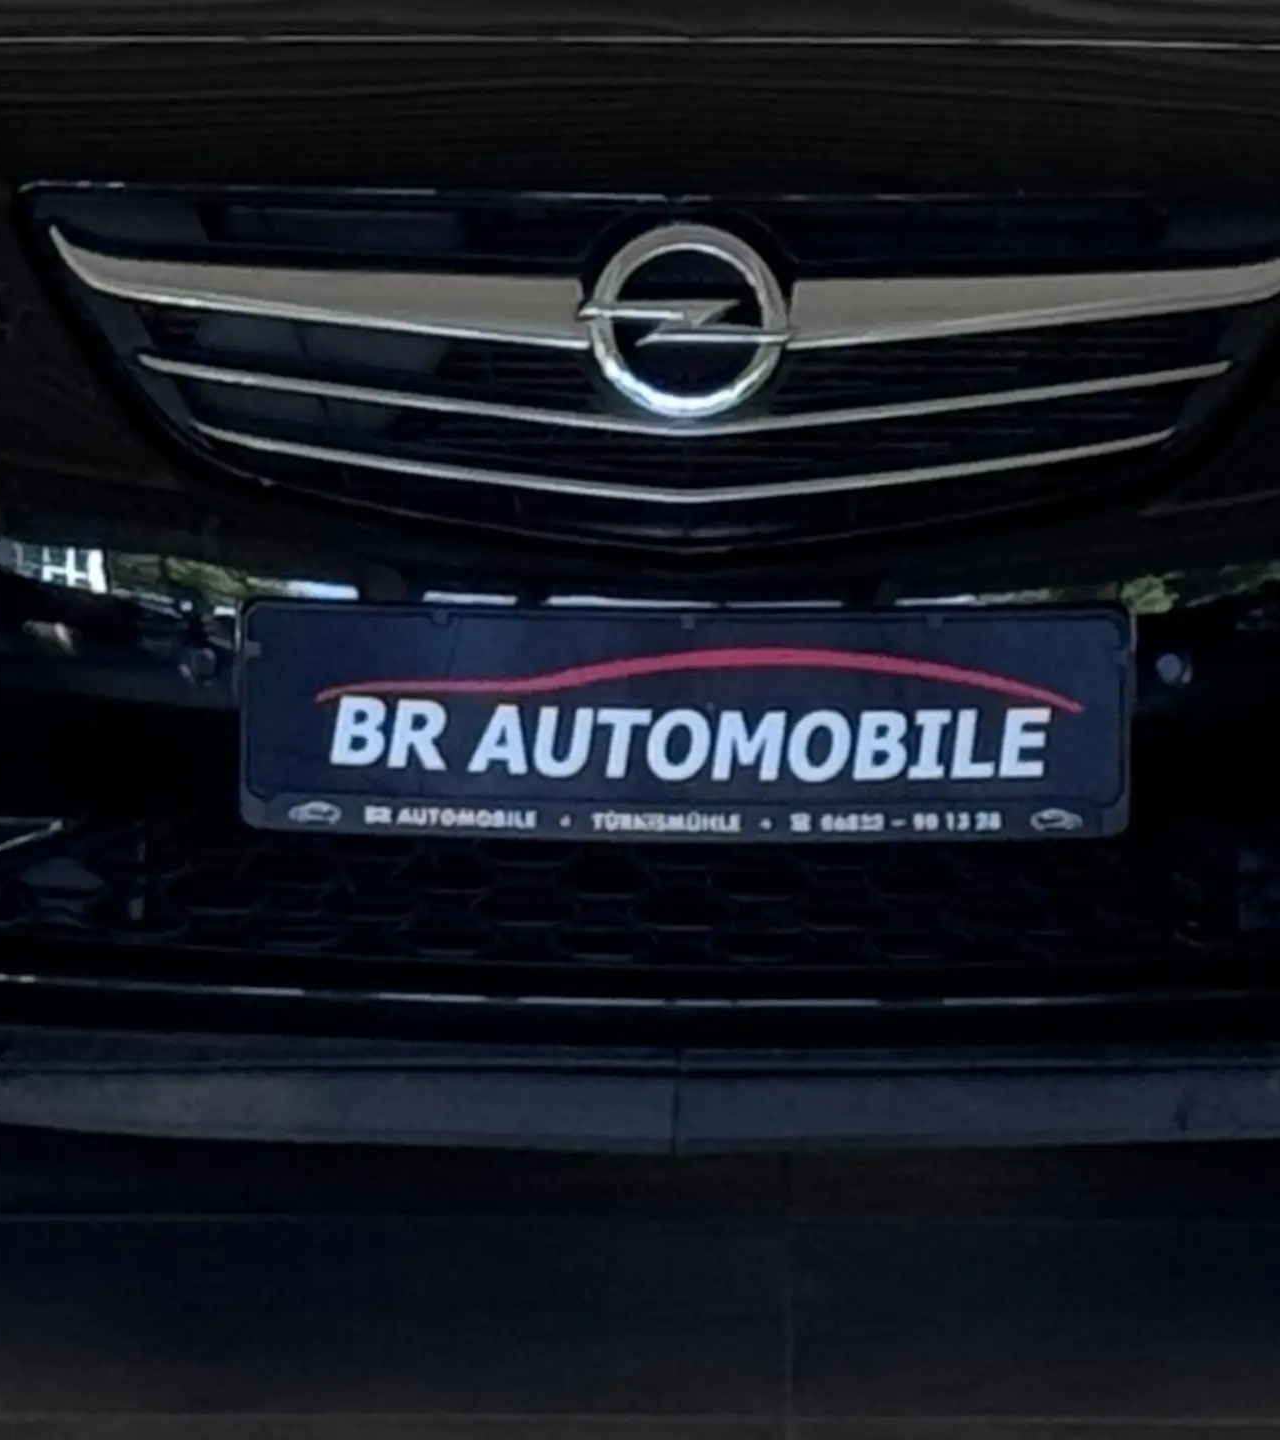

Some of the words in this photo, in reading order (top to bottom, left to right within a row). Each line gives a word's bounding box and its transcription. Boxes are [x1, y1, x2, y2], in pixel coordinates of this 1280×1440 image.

[329, 695, 447, 772] BR
[467, 703, 1052, 783] AUTOMOBILE
[396, 806, 538, 830] AUTOMOBILE
